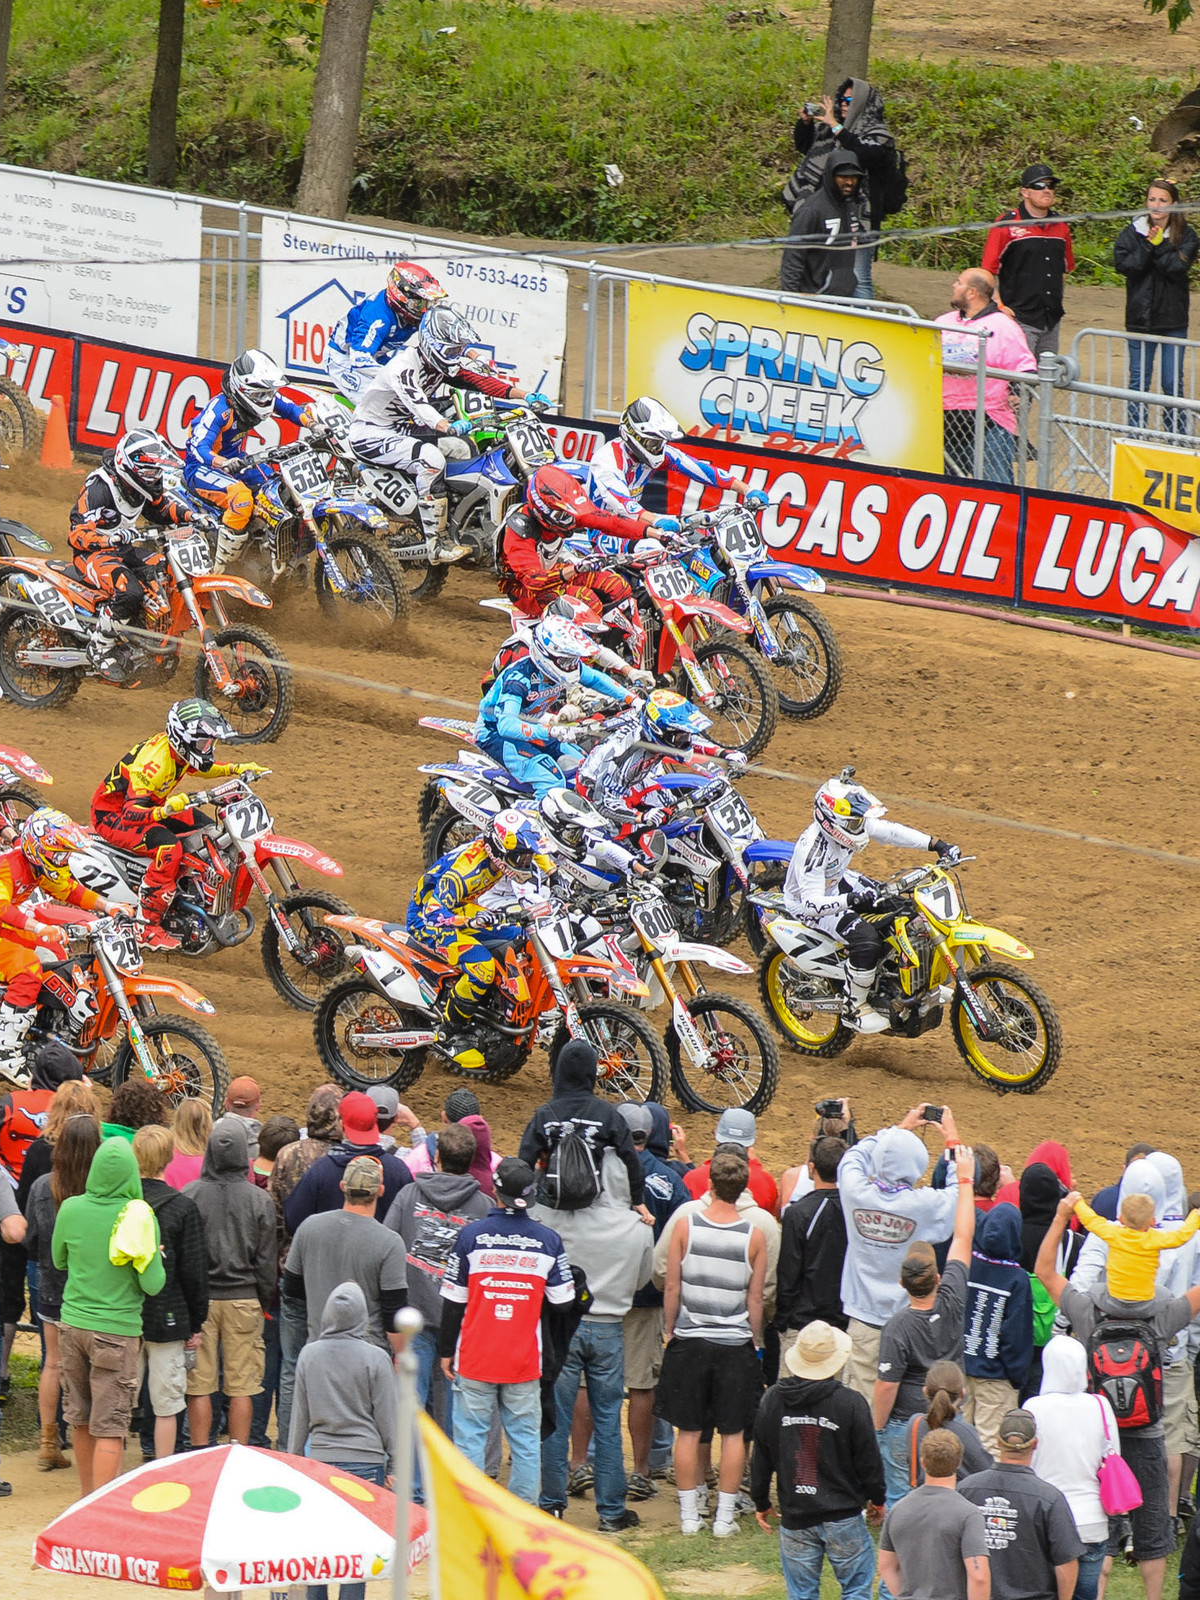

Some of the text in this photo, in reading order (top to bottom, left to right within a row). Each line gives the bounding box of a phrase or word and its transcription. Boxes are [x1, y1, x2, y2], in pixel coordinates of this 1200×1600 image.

[14, 193, 53, 209] MOTORS
[71, 202, 137, 223] SNOWMOBILES
[824, 218, 842, 246] 7
[283, 233, 379, 266] Stewartville,
[74, 265, 112, 282] SERVICE
[446, 261, 548, 293] 507-533-4255
[68, 288, 172, 316] Serving The Rochester
[465, 305, 520, 329] HOUSE
[82, 307, 158, 329] Area Since 1979
[292, 320, 331, 365] HO
[679, 312, 886, 397] SPRING
[87, 358, 284, 456] LUCS
[699, 376, 868, 446] CREEK
[517, 426, 552, 459] 206
[288, 459, 329, 494] 535
[374, 471, 413, 507] 206
[1143, 469, 1200, 513] ZIE
[680, 458, 1004, 580] LUCAS OIL
[725, 526, 762, 555] 49
[178, 543, 212, 574] 945
[1032, 511, 1200, 614] LUCA
[653, 569, 689, 600] 316
[34, 585, 74, 626] 945
[463, 785, 492, 804] 10
[236, 800, 269, 839] 22
[464, 806, 489, 826] TOYOT
[720, 799, 752, 838] 33
[261, 841, 314, 859] DISCOUNT
[76, 864, 120, 900] 22
[563, 861, 588, 882] OYOTA
[932, 888, 955, 918] 7
[553, 922, 571, 952] 1
[639, 907, 677, 938] 800
[112, 939, 142, 969] 29
[788, 931, 823, 959] 7
[959, 980, 988, 1023] DUNLOP
[678, 1013, 701, 1052] DUNLOP
[479, 1253, 539, 1270] LUCAS OIL
[488, 1279, 535, 1292] HONDA
[795, 1485, 818, 1496] 2009
[50, 1545, 161, 1585] SHAVED ICE
[238, 1553, 365, 1586] LEMONADE
[166, 1577, 193, 1591] BALLS
